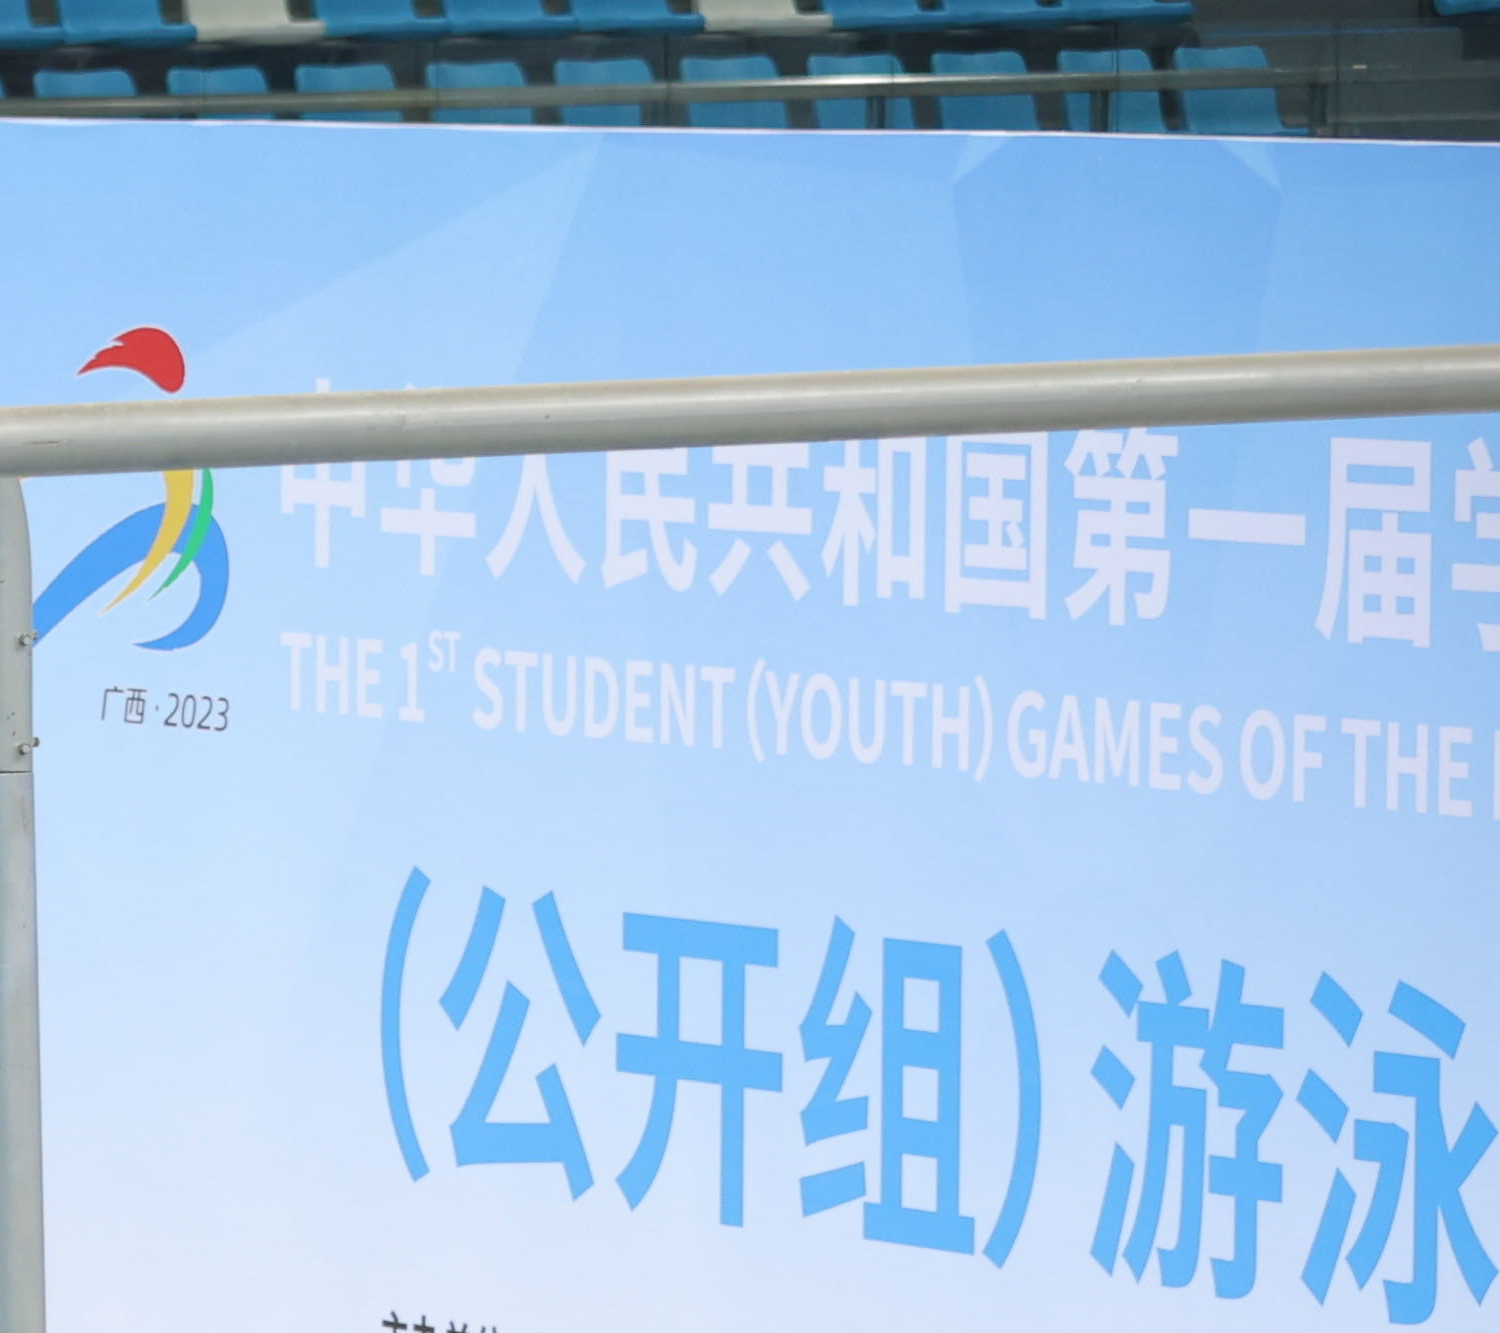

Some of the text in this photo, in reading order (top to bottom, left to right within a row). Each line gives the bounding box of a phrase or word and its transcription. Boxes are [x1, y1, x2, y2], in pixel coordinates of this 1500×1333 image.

[279, 630, 383, 719] THE
[472, 646, 735, 750] STUDENT
[747, 657, 994, 784] (YOUTH)
[1006, 688, 1224, 796] GAMES
[1239, 708, 1327, 803] OF
[1341, 716, 1474, 819] THE
